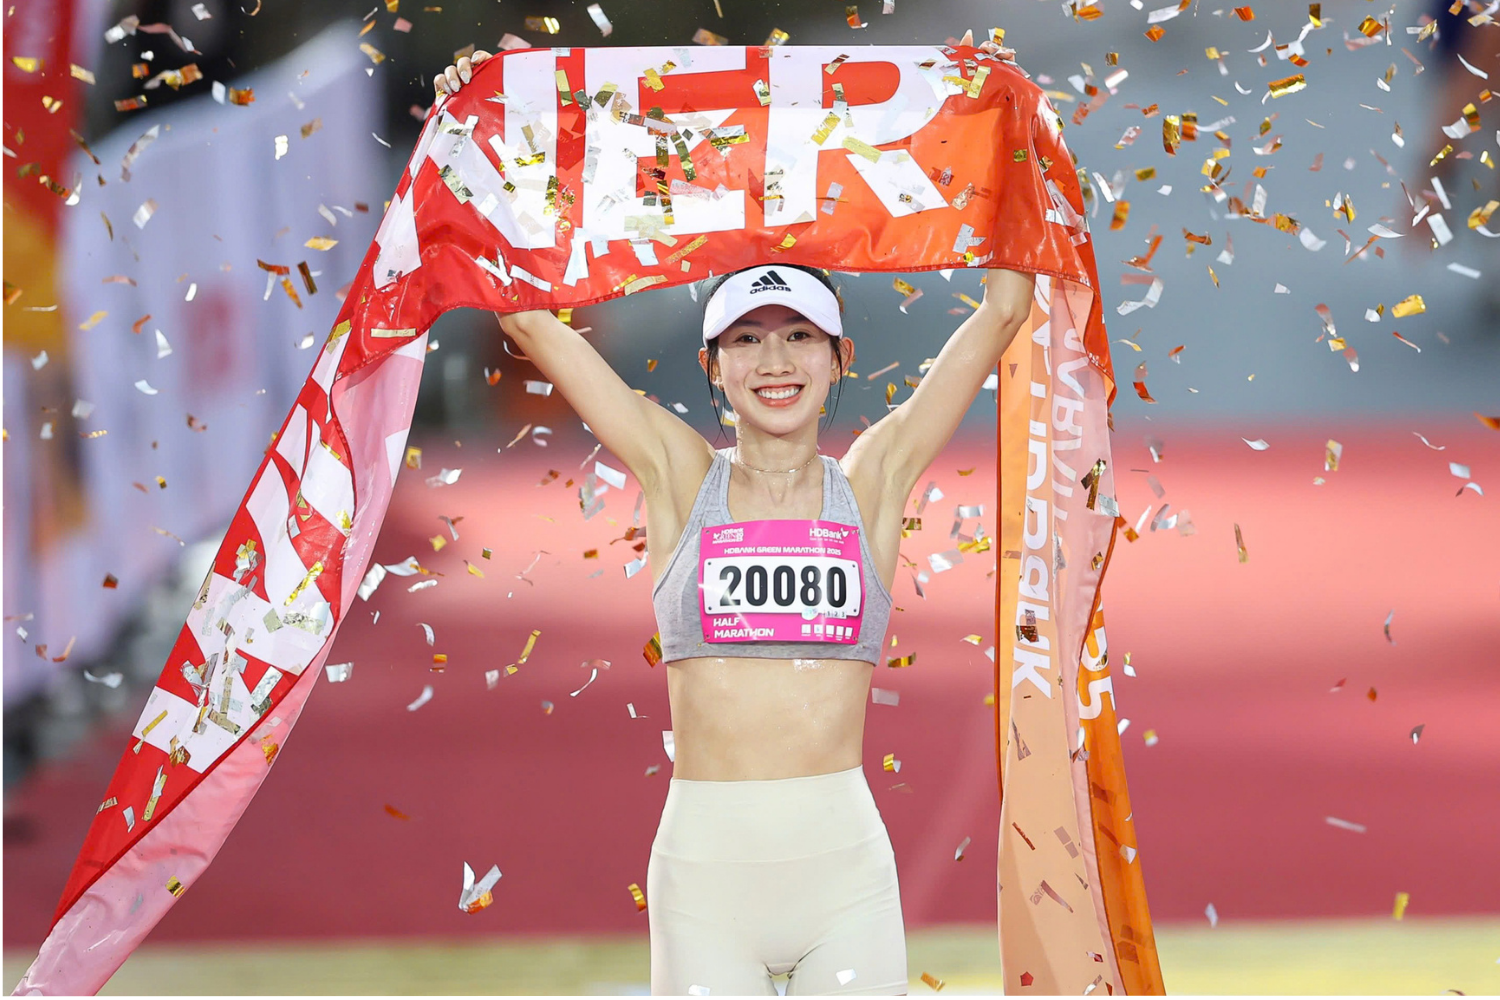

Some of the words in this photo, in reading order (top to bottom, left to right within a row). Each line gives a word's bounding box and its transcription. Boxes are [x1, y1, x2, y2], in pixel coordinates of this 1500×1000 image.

[749, 282, 792, 295] adidas
[809, 527, 843, 540] HDBank
[724, 546, 756, 555] HDBANK
[756, 546, 782, 554] GREEN
[783, 546, 826, 554] MARATHON
[826, 548, 842, 556] 2025
[719, 564, 848, 608] 20080
[713, 617, 741, 627] HALF
[714, 628, 774, 639] MARATHON
